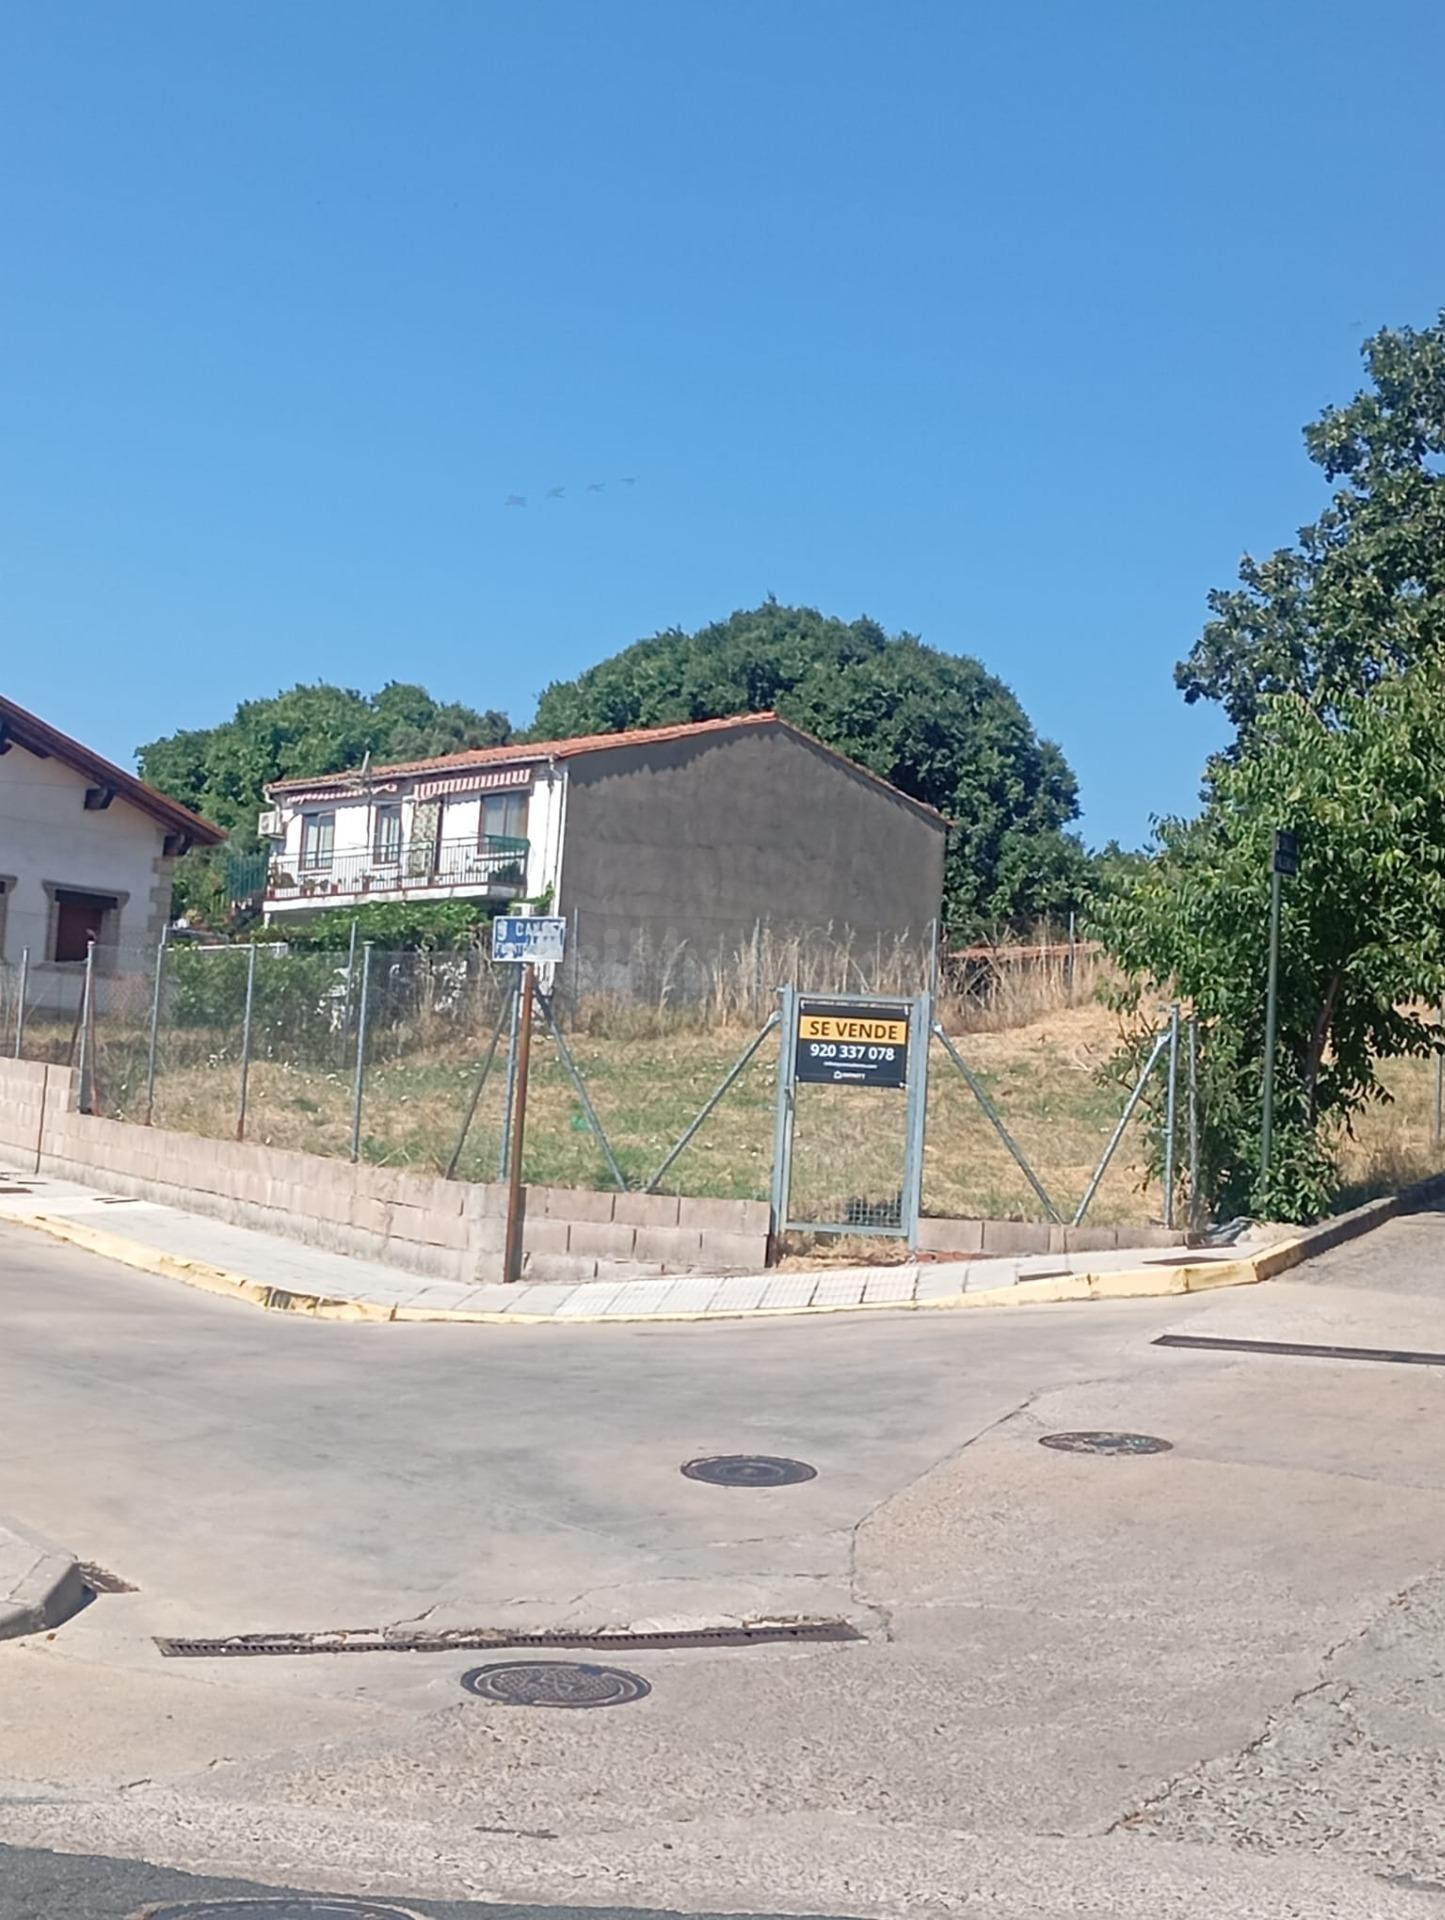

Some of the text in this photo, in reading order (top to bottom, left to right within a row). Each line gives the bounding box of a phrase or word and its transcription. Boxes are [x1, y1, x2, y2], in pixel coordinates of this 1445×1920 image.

[809, 1020, 898, 1040] SE VENDE
[810, 1043, 895, 1061] 920 337 078
